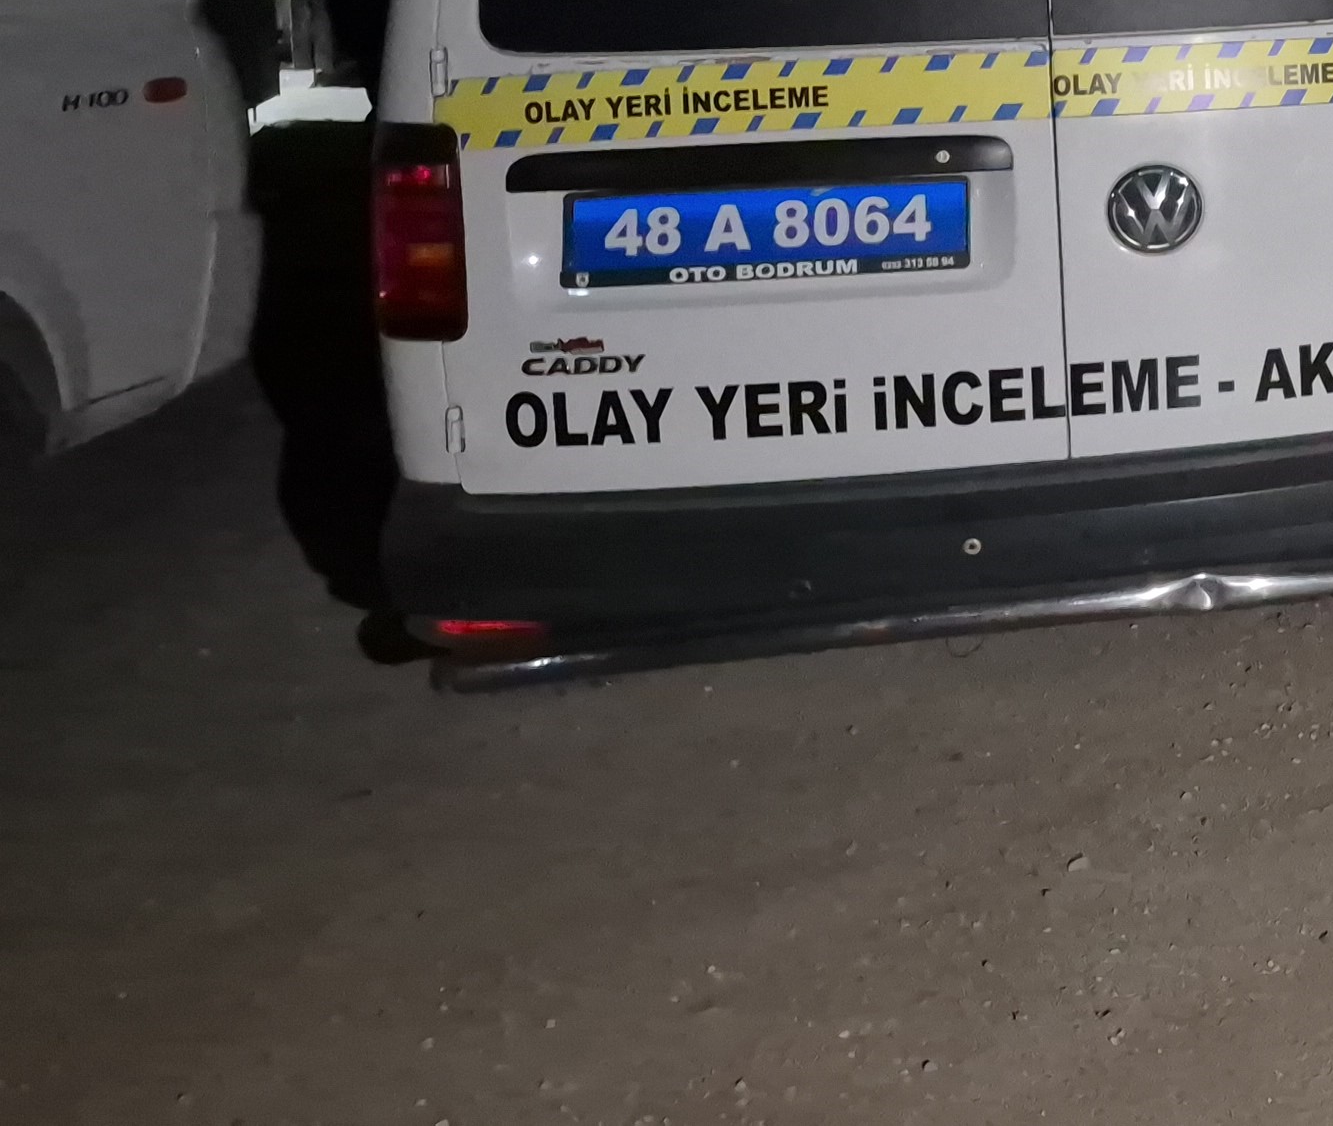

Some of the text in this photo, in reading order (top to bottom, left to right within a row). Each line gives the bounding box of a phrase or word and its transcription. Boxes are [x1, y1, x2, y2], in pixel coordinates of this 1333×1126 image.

[1053, 72, 1122, 96] OLAY
[524, 85, 829, 123] OLAY YERİ İNCELEME
[604, 193, 932, 257] 48 A 8064
[669, 265, 726, 284] OTO
[735, 258, 858, 281] BODRUM
[521, 353, 646, 375] CADDY
[505, 387, 673, 448] OLAY
